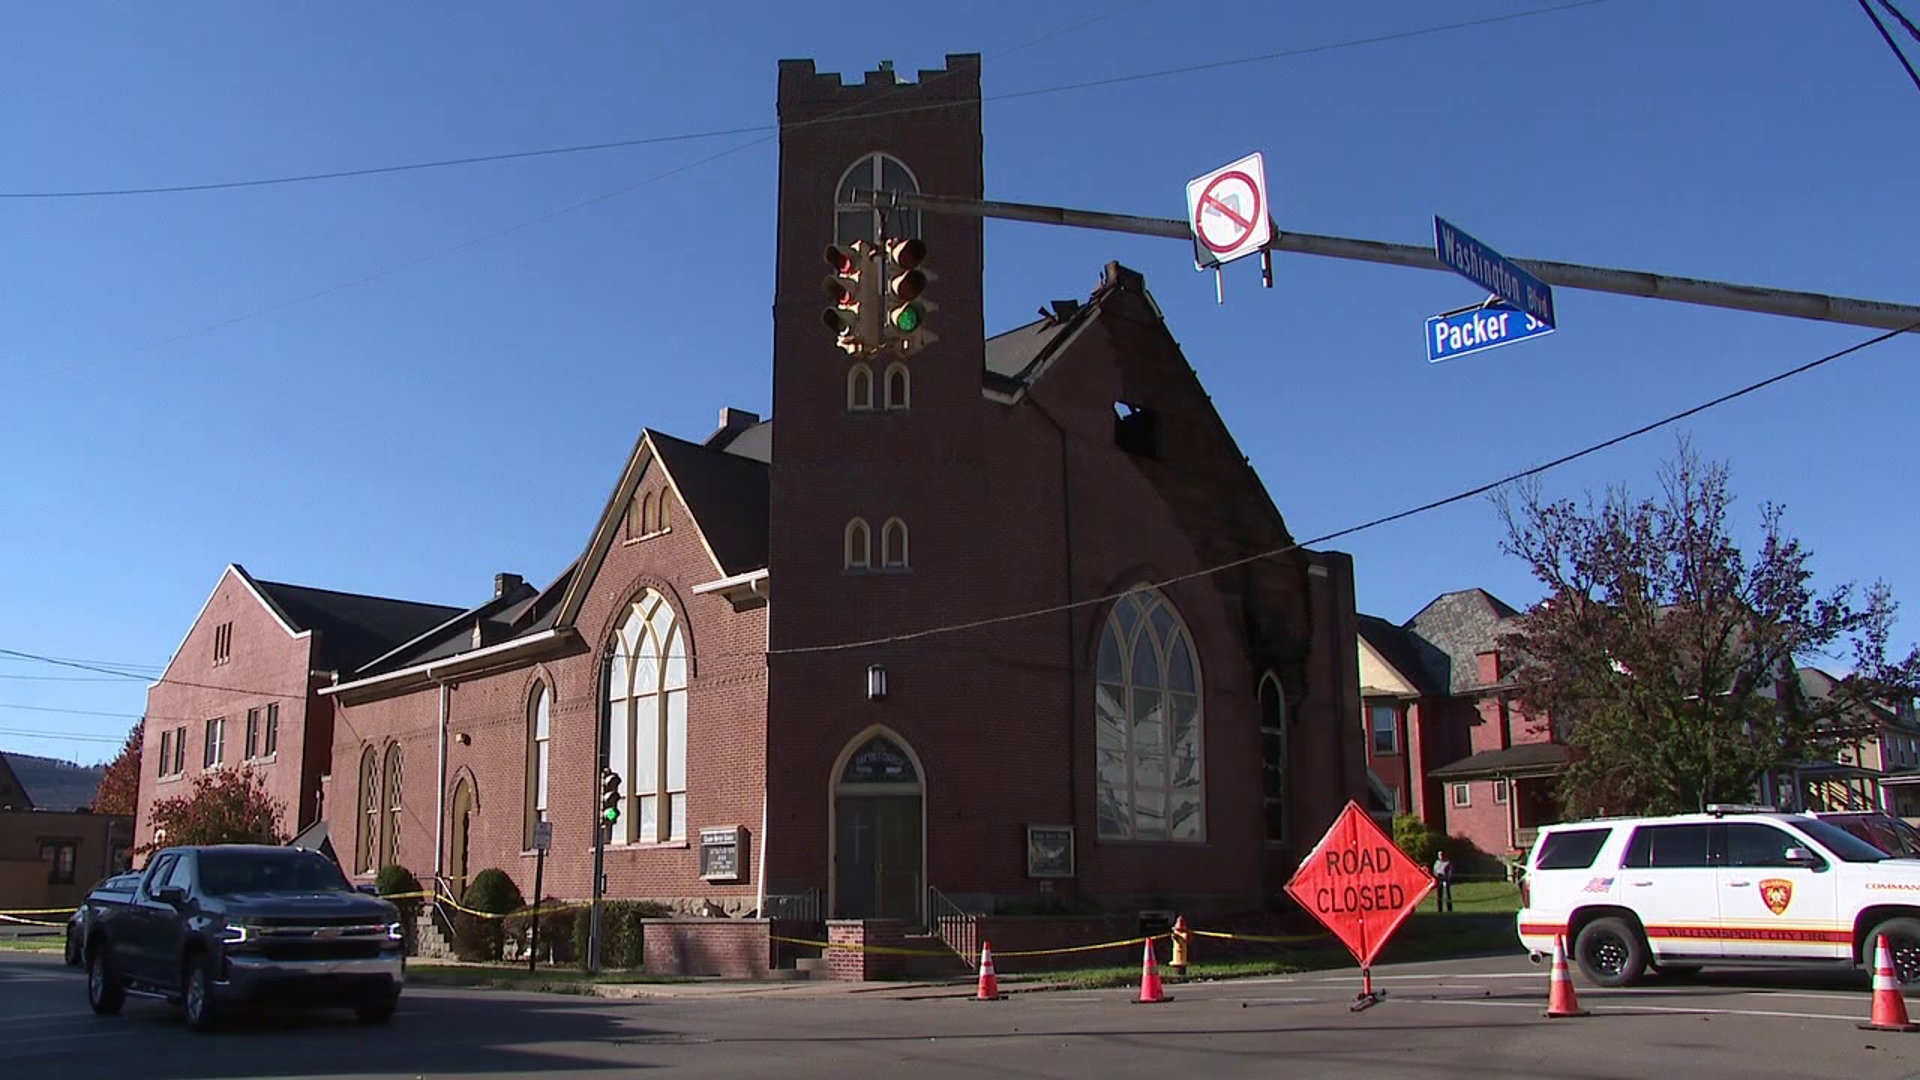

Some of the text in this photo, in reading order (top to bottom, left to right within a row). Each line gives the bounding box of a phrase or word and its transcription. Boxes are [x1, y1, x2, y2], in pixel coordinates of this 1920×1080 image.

[1442, 225, 1548, 319] Washington Blvd
[1434, 312, 1545, 353] Packer S
[1325, 847, 1392, 877] ROAD
[1316, 884, 1405, 914] CLOSED
